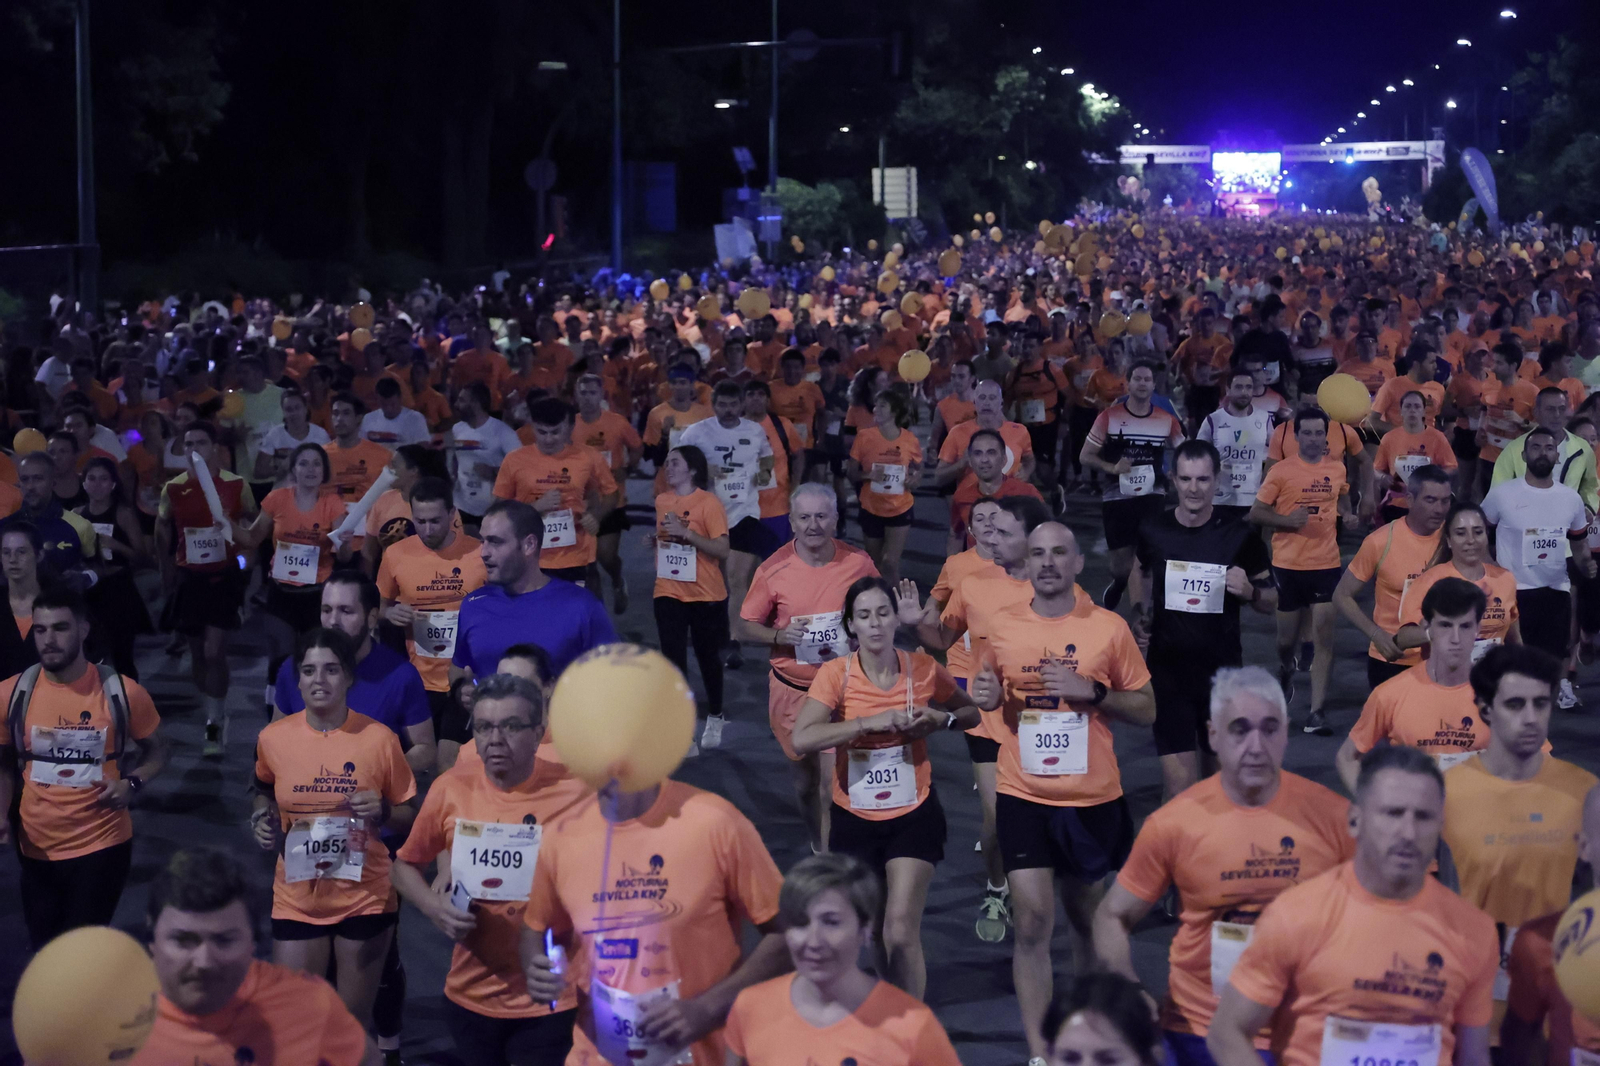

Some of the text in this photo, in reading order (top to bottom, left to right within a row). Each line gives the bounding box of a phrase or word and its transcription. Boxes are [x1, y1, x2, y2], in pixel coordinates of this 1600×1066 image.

[1224, 445, 1256, 460] Jaén
[1129, 475, 1147, 484] 8227
[193, 538, 219, 549] 15563
[1532, 539, 1557, 550] 13246
[283, 555, 310, 568] 15144
[666, 554, 688, 566] 12373
[1182, 579, 1211, 593] 7175
[427, 627, 454, 639] 8677
[810, 628, 838, 643] 7363
[1035, 733, 1070, 749] 3033
[1435, 731, 1475, 739] NOCTURNA
[1417, 738, 1452, 747] SEVILLA
[313, 777, 358, 785] NOCTURNA
[866, 767, 899, 785] 3031
[293, 785, 332, 793] SEVILLA
[303, 839, 347, 856] 10552
[470, 848, 523, 869] 14509
[1246, 858, 1300, 867] NOCTURNA
[1221, 869, 1270, 881] SEVILLA
[616, 878, 669, 888] NOCTURNA
[593, 890, 639, 903] SEVILLA
